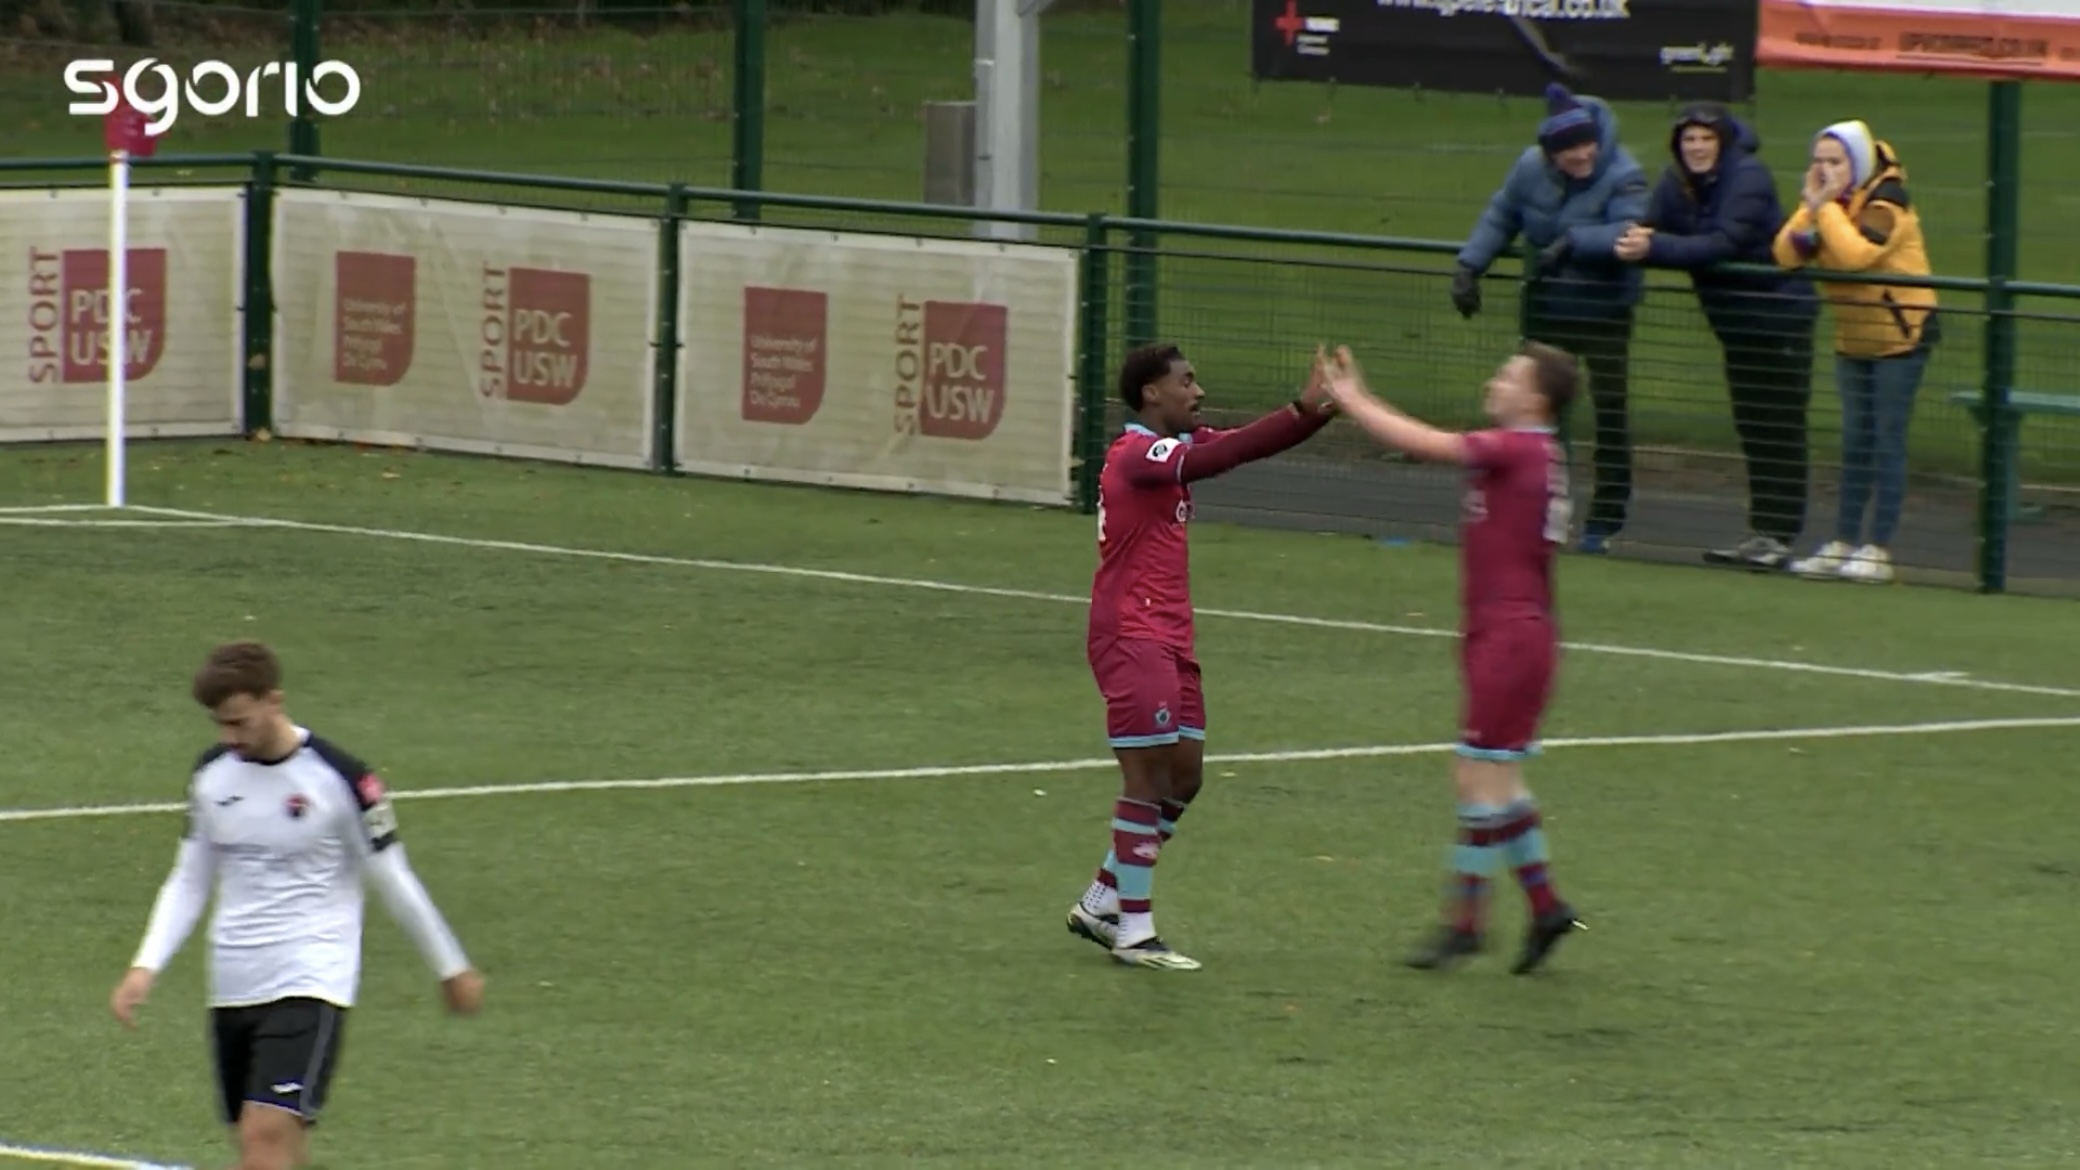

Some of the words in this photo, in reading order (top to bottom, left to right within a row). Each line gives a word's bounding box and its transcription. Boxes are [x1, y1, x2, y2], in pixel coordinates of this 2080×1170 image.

[29, 246, 57, 383] SPORT
[481, 261, 505, 398] SPORT
[513, 308, 573, 348] PDC
[513, 349, 578, 388] USW
[893, 294, 920, 436] SPORT
[928, 341, 989, 381] PDC
[924, 381, 995, 424] USW
